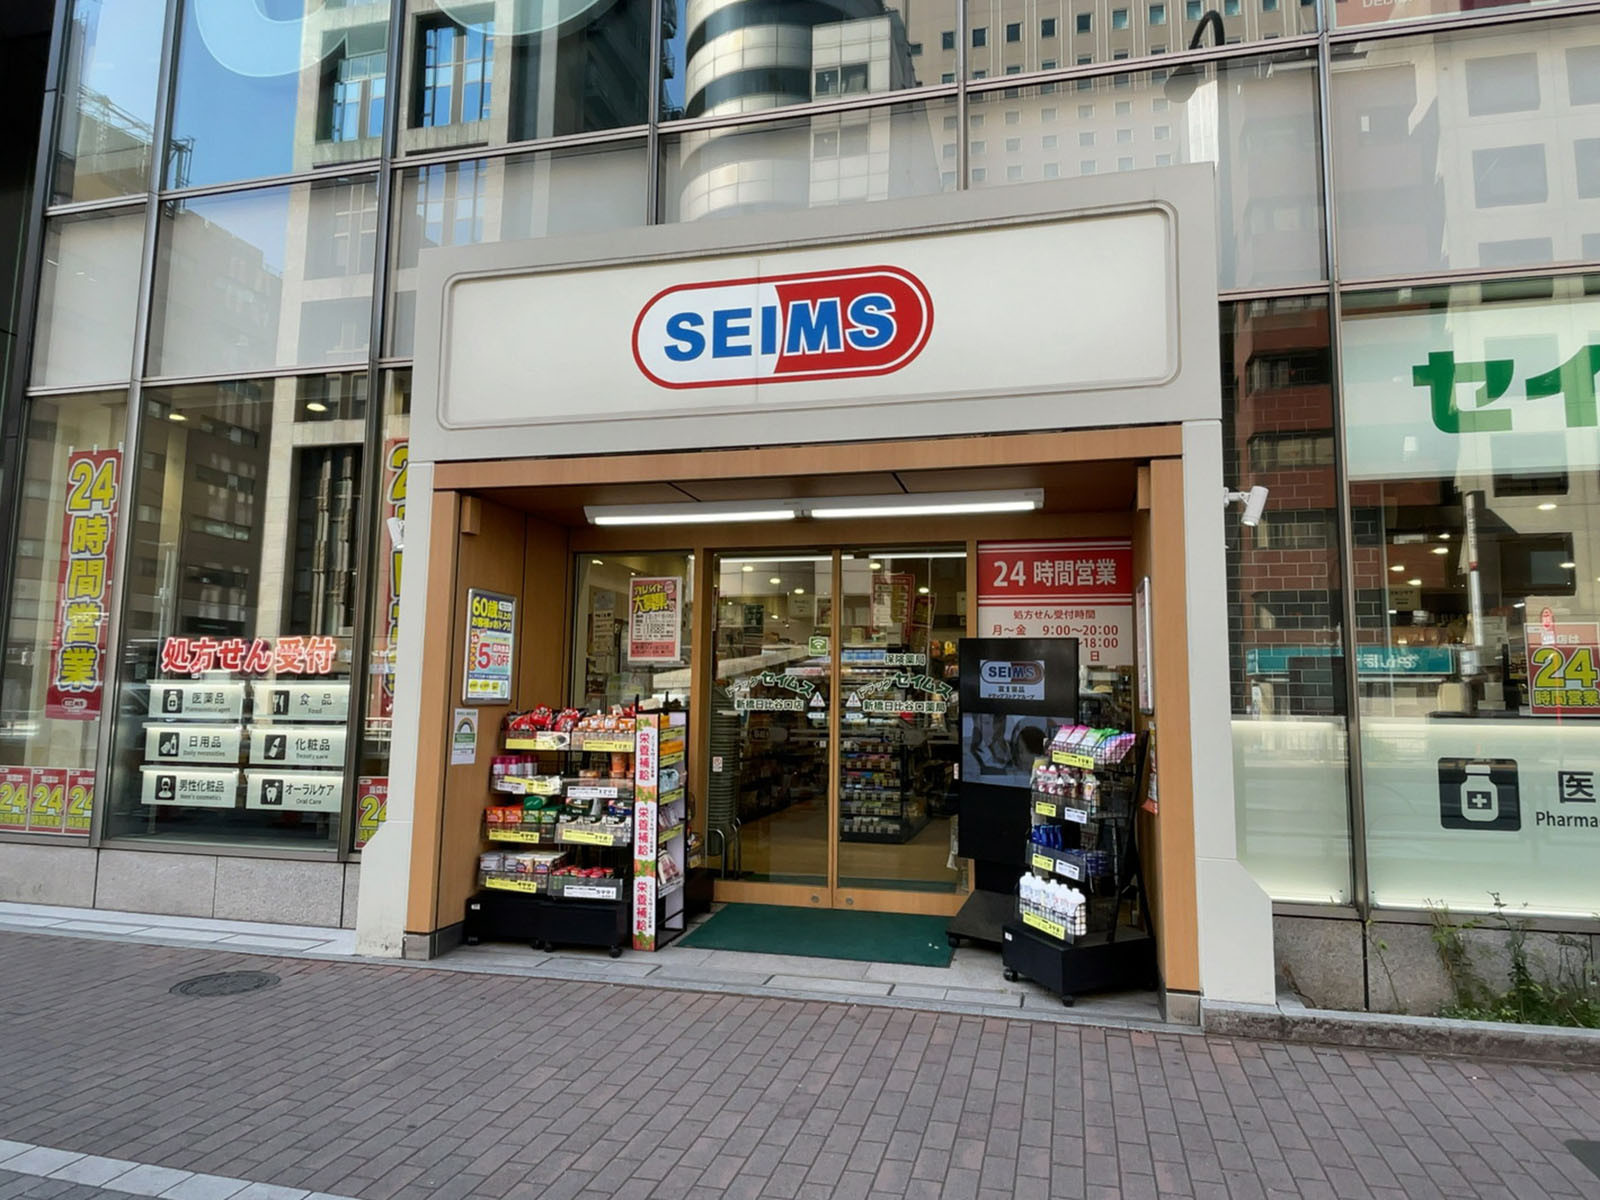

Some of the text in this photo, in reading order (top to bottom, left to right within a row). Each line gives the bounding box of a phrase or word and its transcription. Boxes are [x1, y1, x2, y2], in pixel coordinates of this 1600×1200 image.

[663, 292, 897, 362] SEIMS
[1413, 343, 1600, 434] セイ
[60, 459, 117, 691] 24時間営業
[993, 559, 1116, 587] 24 時間営業
[1013, 609, 1096, 620] 処方せん受付時間
[1542, 632, 1580, 646] 店は
[161, 636, 336, 674] 処方せん受付
[988, 665, 1036, 679] SEIMS
[1532, 646, 1599, 689] 24
[192, 692, 225, 705] 医薬品
[1533, 689, 1600, 707] 時間営業
[189, 735, 222, 749] 日用品
[295, 738, 331, 752] 化粧品
[178, 778, 225, 794] 男性化粧品
[285, 783, 336, 798] オーラルケア
[1558, 770, 1596, 803] 医
[0, 782, 29, 812] 24
[33, 784, 65, 814] 24
[1536, 811, 1600, 828] Pharma
